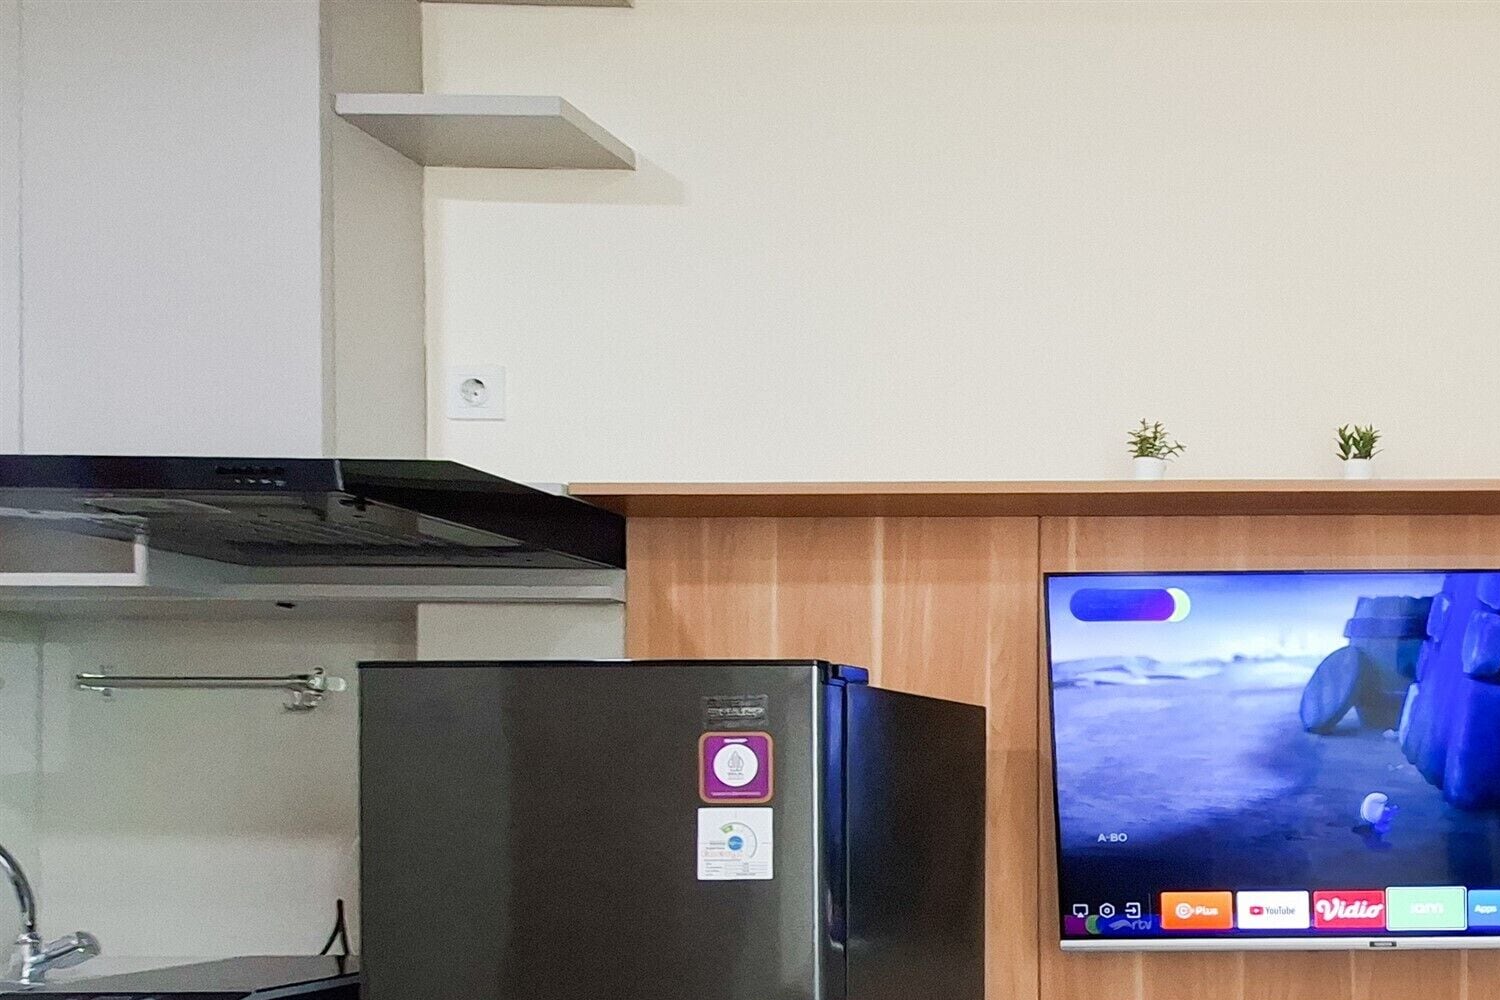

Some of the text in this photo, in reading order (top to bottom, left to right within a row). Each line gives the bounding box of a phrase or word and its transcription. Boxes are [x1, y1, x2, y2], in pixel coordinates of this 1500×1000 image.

[1265, 906, 1296, 915] YouTube
[1316, 897, 1384, 921] Vidio
[1474, 903, 1498, 915] Apps
